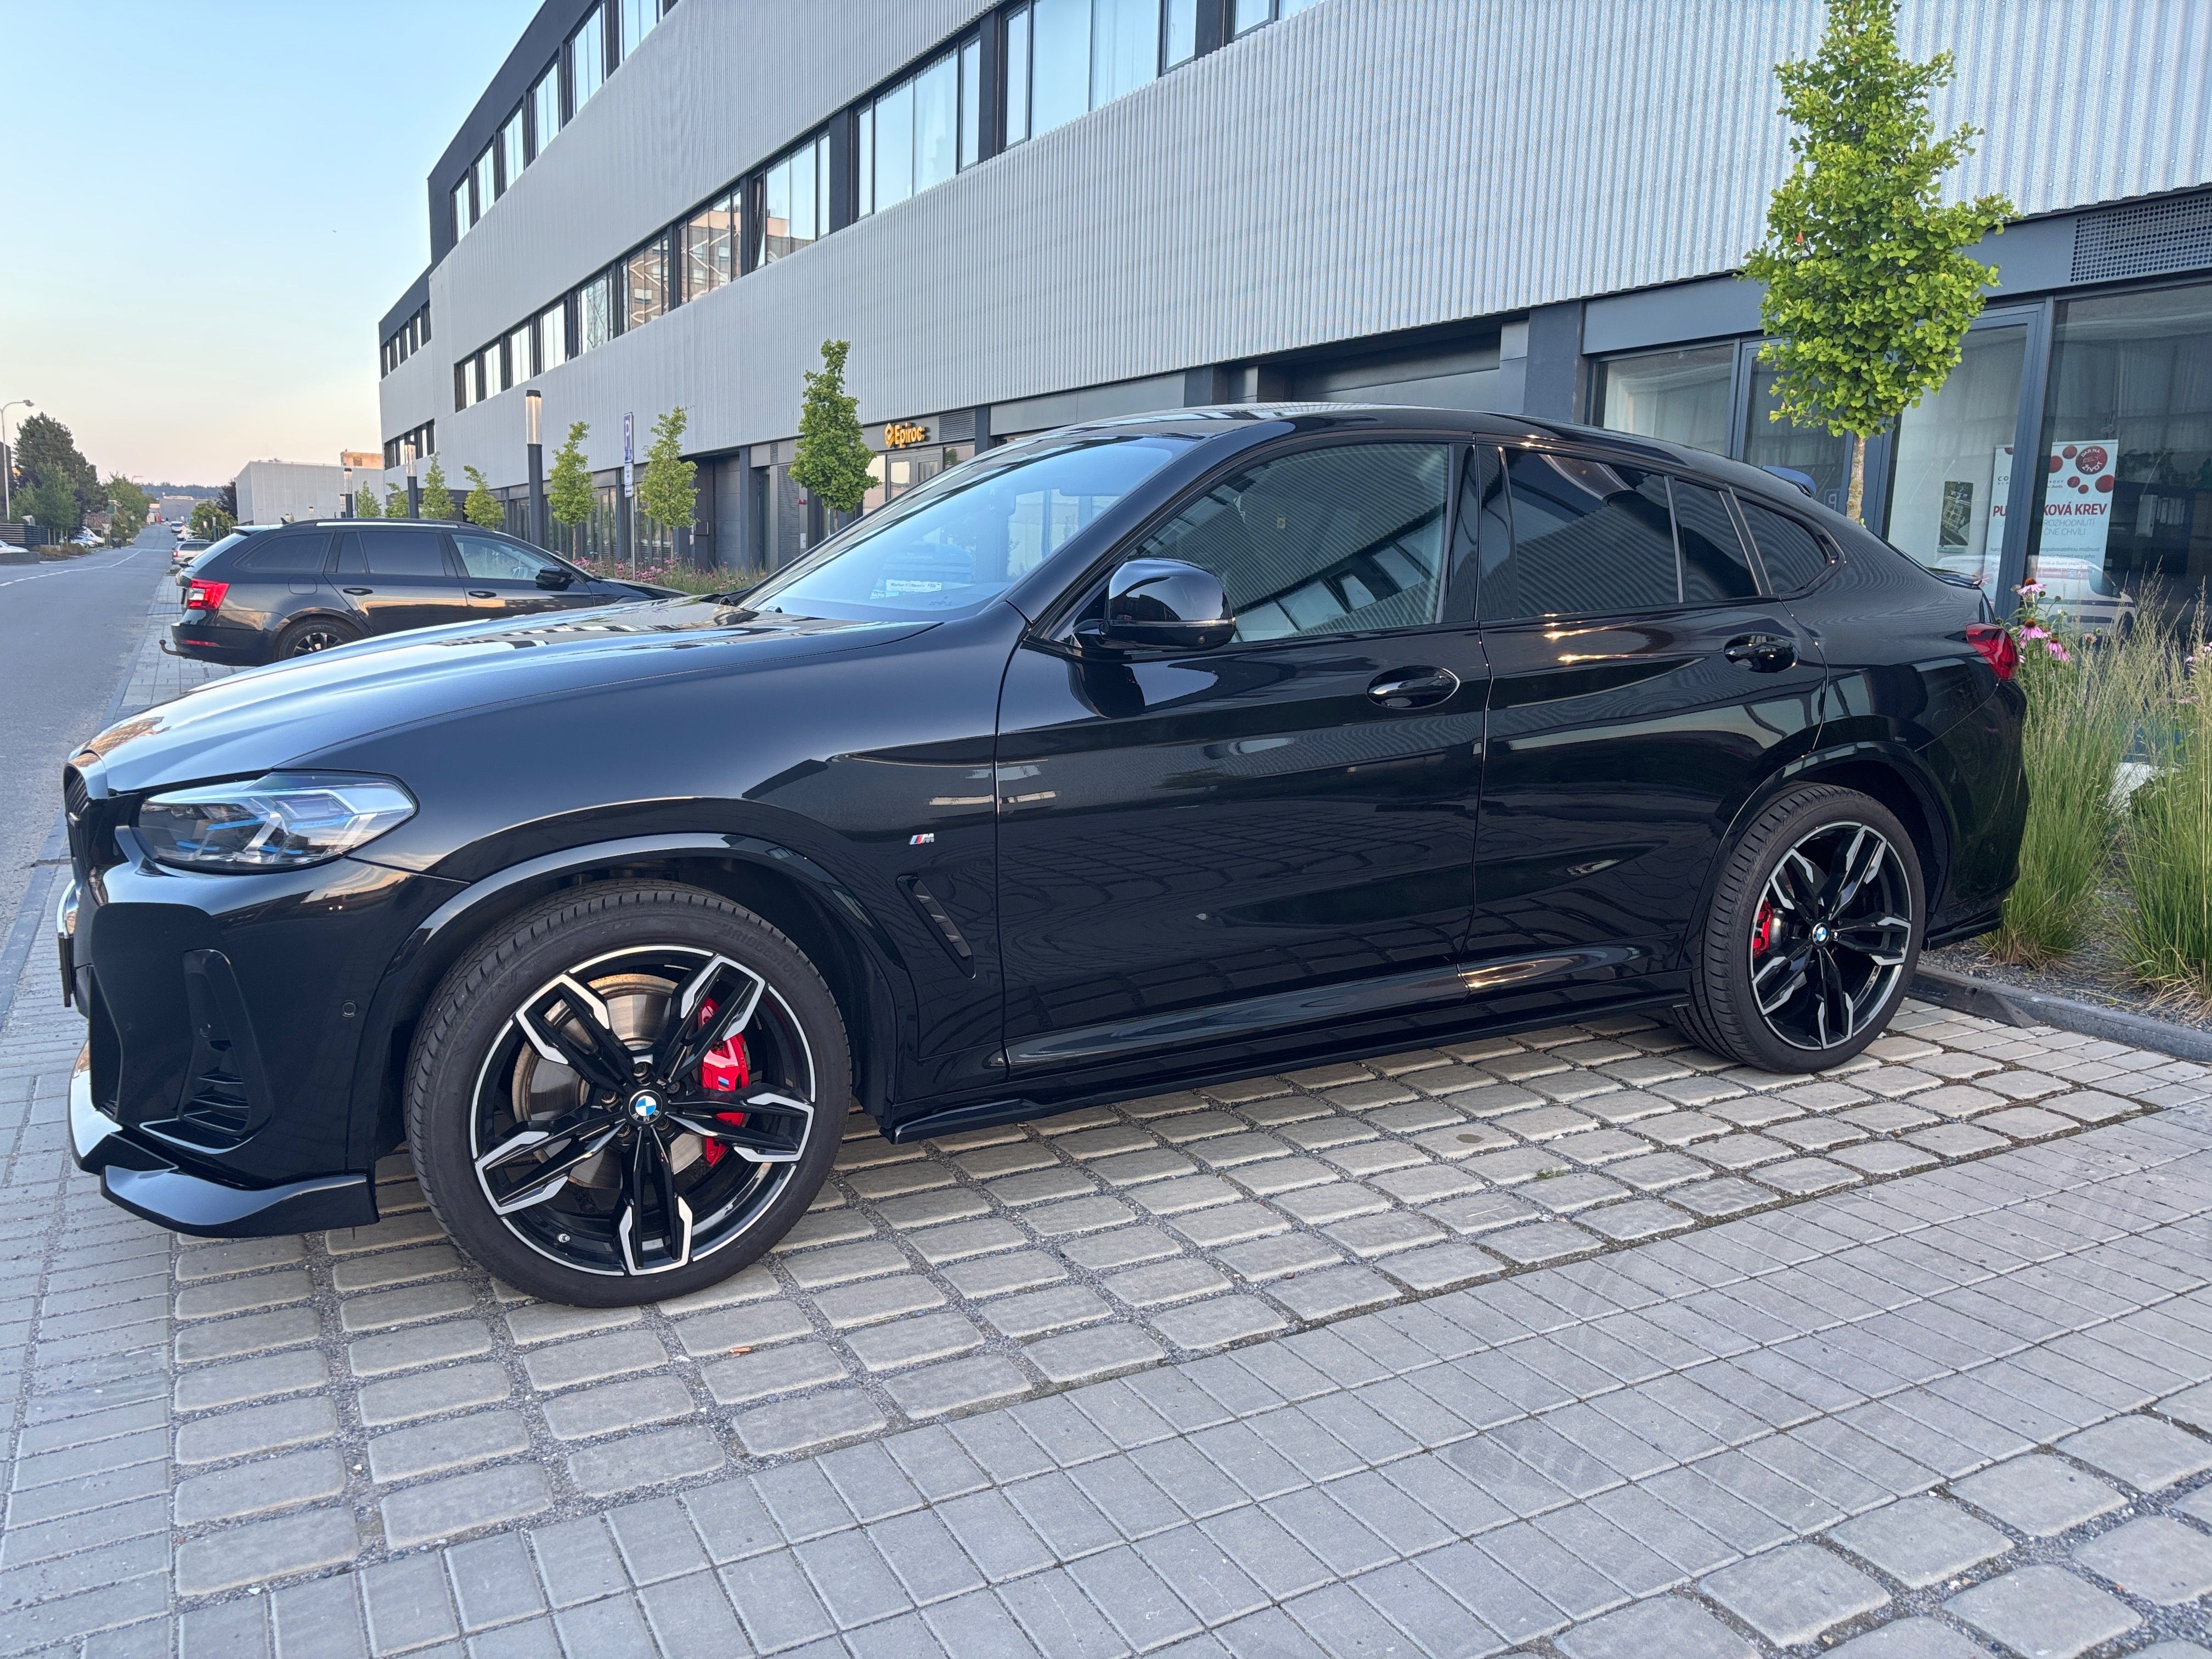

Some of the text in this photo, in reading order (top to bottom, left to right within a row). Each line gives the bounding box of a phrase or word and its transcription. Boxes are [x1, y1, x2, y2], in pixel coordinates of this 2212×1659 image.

[894, 421, 926, 448] Epiroc
[2081, 461, 2103, 472] ŽIVOT
[2075, 503, 2108, 516] KREV
